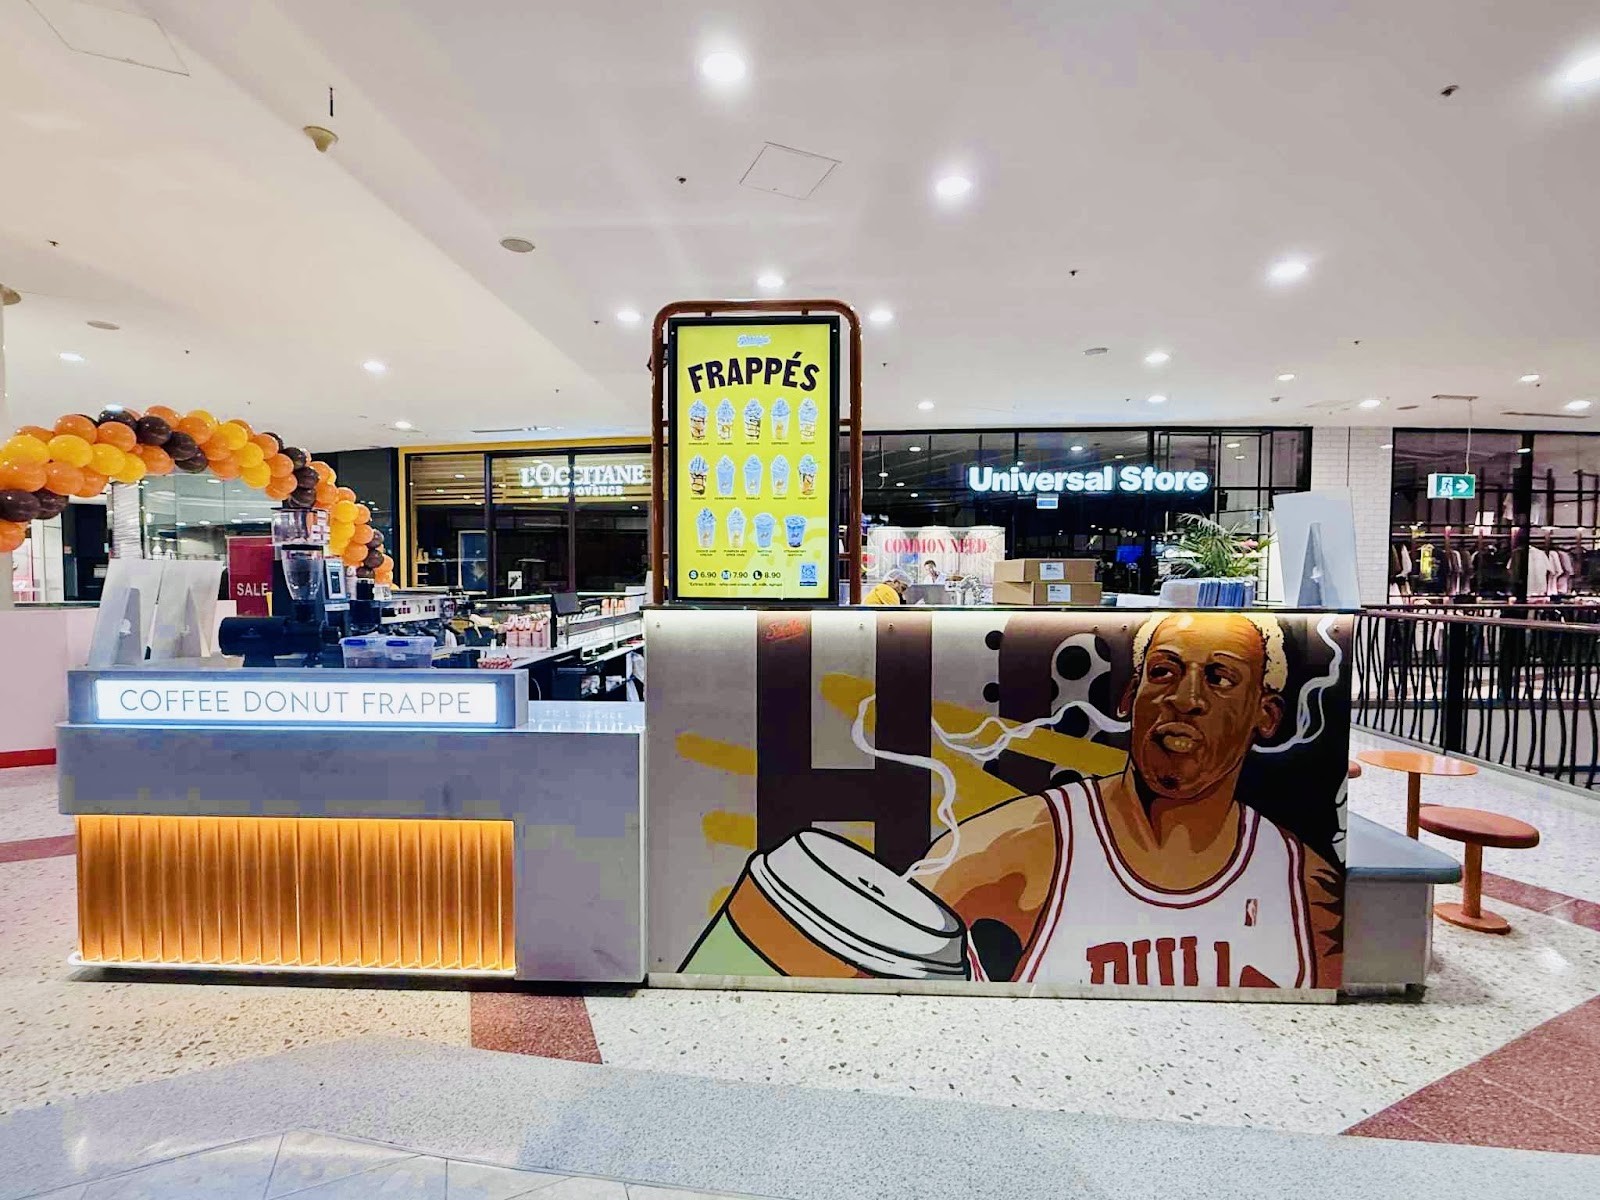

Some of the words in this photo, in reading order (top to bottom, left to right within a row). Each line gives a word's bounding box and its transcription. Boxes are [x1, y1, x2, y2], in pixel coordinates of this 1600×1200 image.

[688, 351, 820, 393] FRAPPÉS
[520, 463, 646, 487] L'OCCITANE
[969, 466, 1112, 492] Universal
[1119, 466, 1209, 492] Store
[884, 537, 945, 554] COMMON
[951, 537, 988, 554] NEED
[700, 571, 716, 579] 6.90
[733, 571, 748, 579] 7.90
[764, 571, 781, 579] 8.90
[236, 582, 269, 597] SALE
[120, 689, 230, 713] COFFEE
[244, 690, 349, 714] DONUT
[362, 691, 471, 715] FRAPPE
